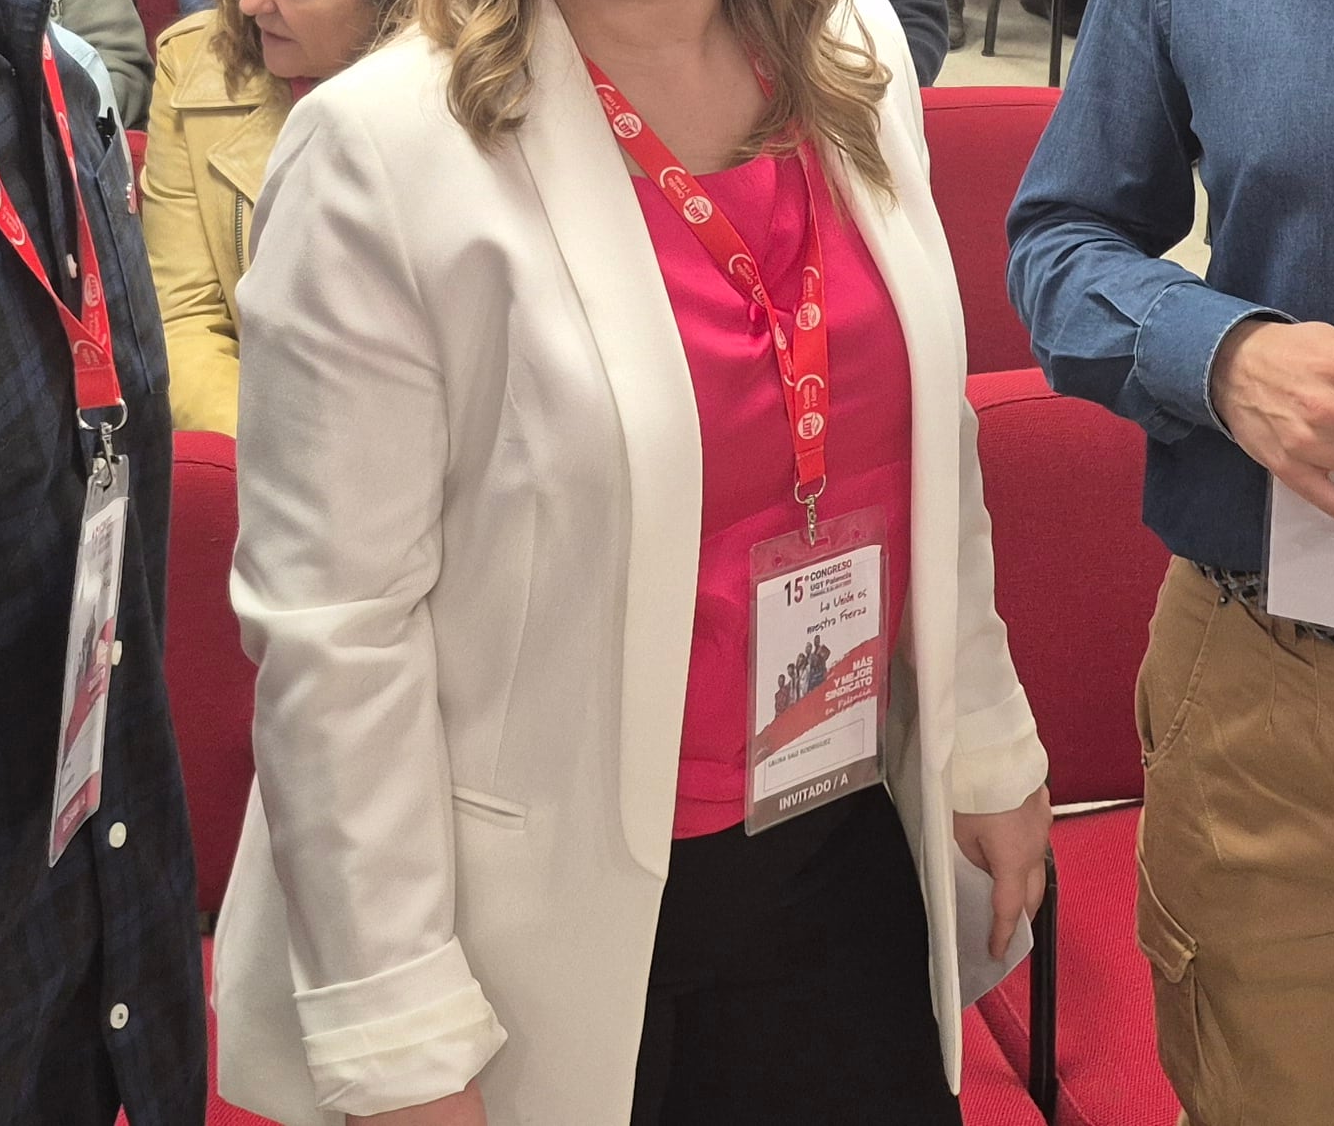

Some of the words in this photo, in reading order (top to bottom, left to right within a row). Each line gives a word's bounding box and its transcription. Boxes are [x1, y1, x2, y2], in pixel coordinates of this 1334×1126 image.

[615, 116, 636, 137] UGT
[685, 199, 706, 222] UGT
[810, 559, 853, 582] CONGRESO
[810, 581, 825, 592] UGT
[825, 572, 852, 587] Palencia
[807, 617, 836, 635] nuestra
[834, 678, 840, 688] Y
[841, 667, 873, 685] MEJOR
[825, 677, 873, 702] SINDICATO
[779, 779, 831, 811] INVITADO
[840, 773, 849, 786] A
